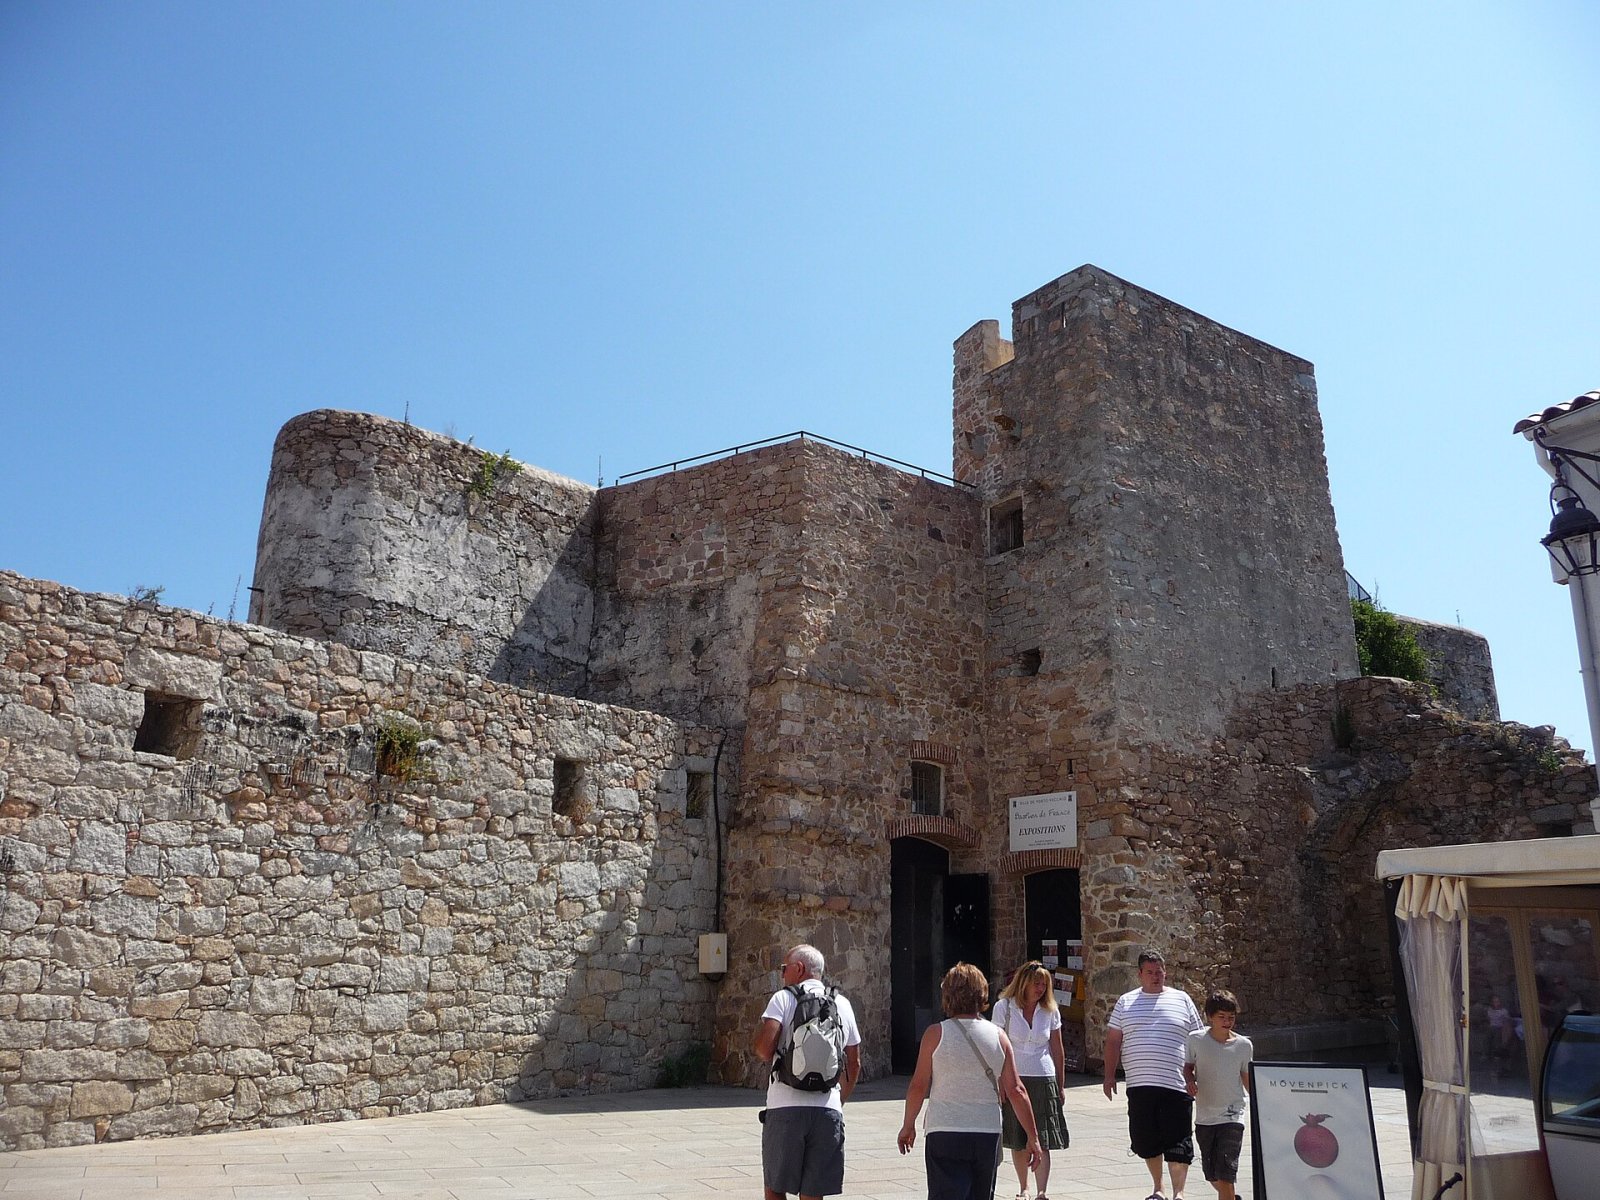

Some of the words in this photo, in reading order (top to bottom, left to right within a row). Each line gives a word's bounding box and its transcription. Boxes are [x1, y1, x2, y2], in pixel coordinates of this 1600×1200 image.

[1048, 808, 1071, 817] France
[1018, 824, 1067, 836] EXPOSITIONS
[1269, 1080, 1350, 1089] MÖVENPICK
